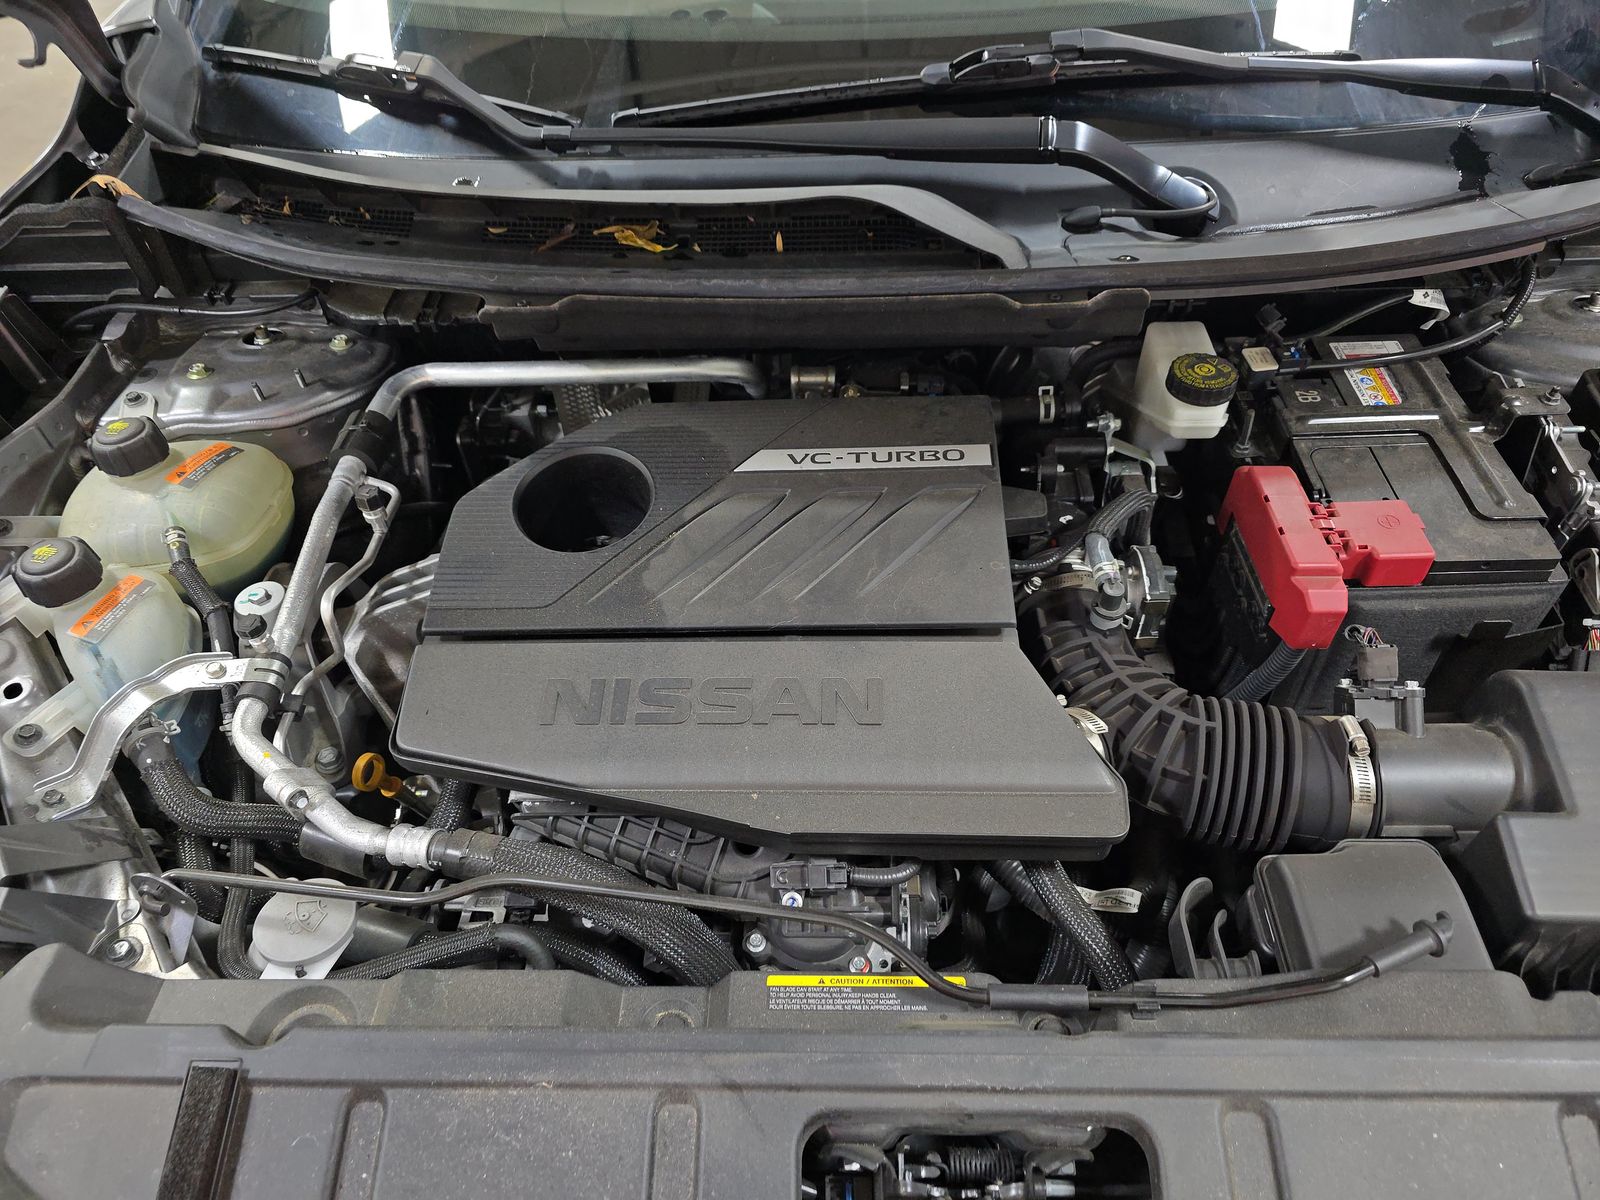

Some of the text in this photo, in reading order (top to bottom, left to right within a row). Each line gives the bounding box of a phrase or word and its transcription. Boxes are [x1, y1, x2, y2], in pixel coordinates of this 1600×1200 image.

[1295, 390, 1321, 403] 2B
[787, 448, 966, 465] VC-TURBO
[540, 677, 883, 726] NISSAN
